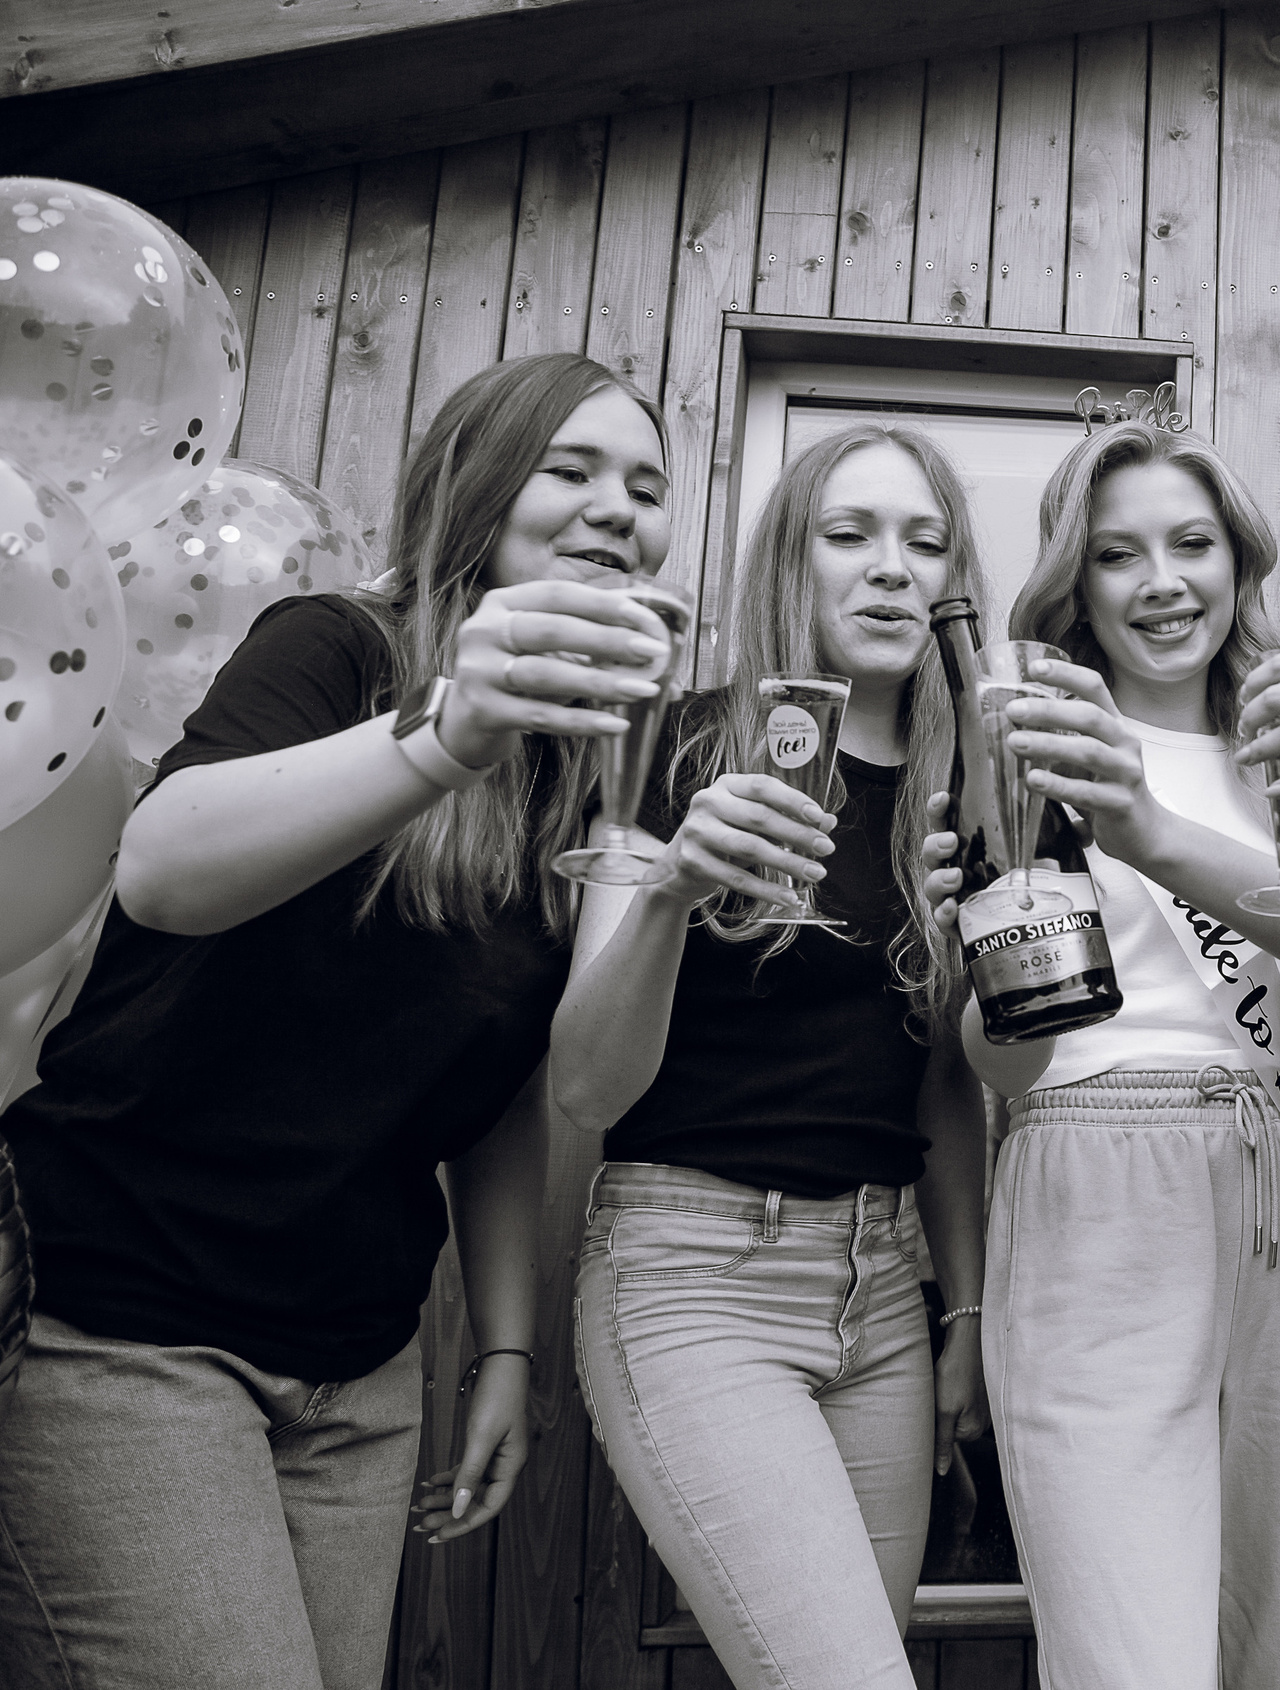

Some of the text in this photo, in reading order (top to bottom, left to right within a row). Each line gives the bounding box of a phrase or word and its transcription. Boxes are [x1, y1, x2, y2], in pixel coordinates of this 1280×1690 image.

[974, 928, 1022, 957] SANTO
[1025, 913, 1093, 941] STEFANO
[1235, 975, 1275, 1056] to
